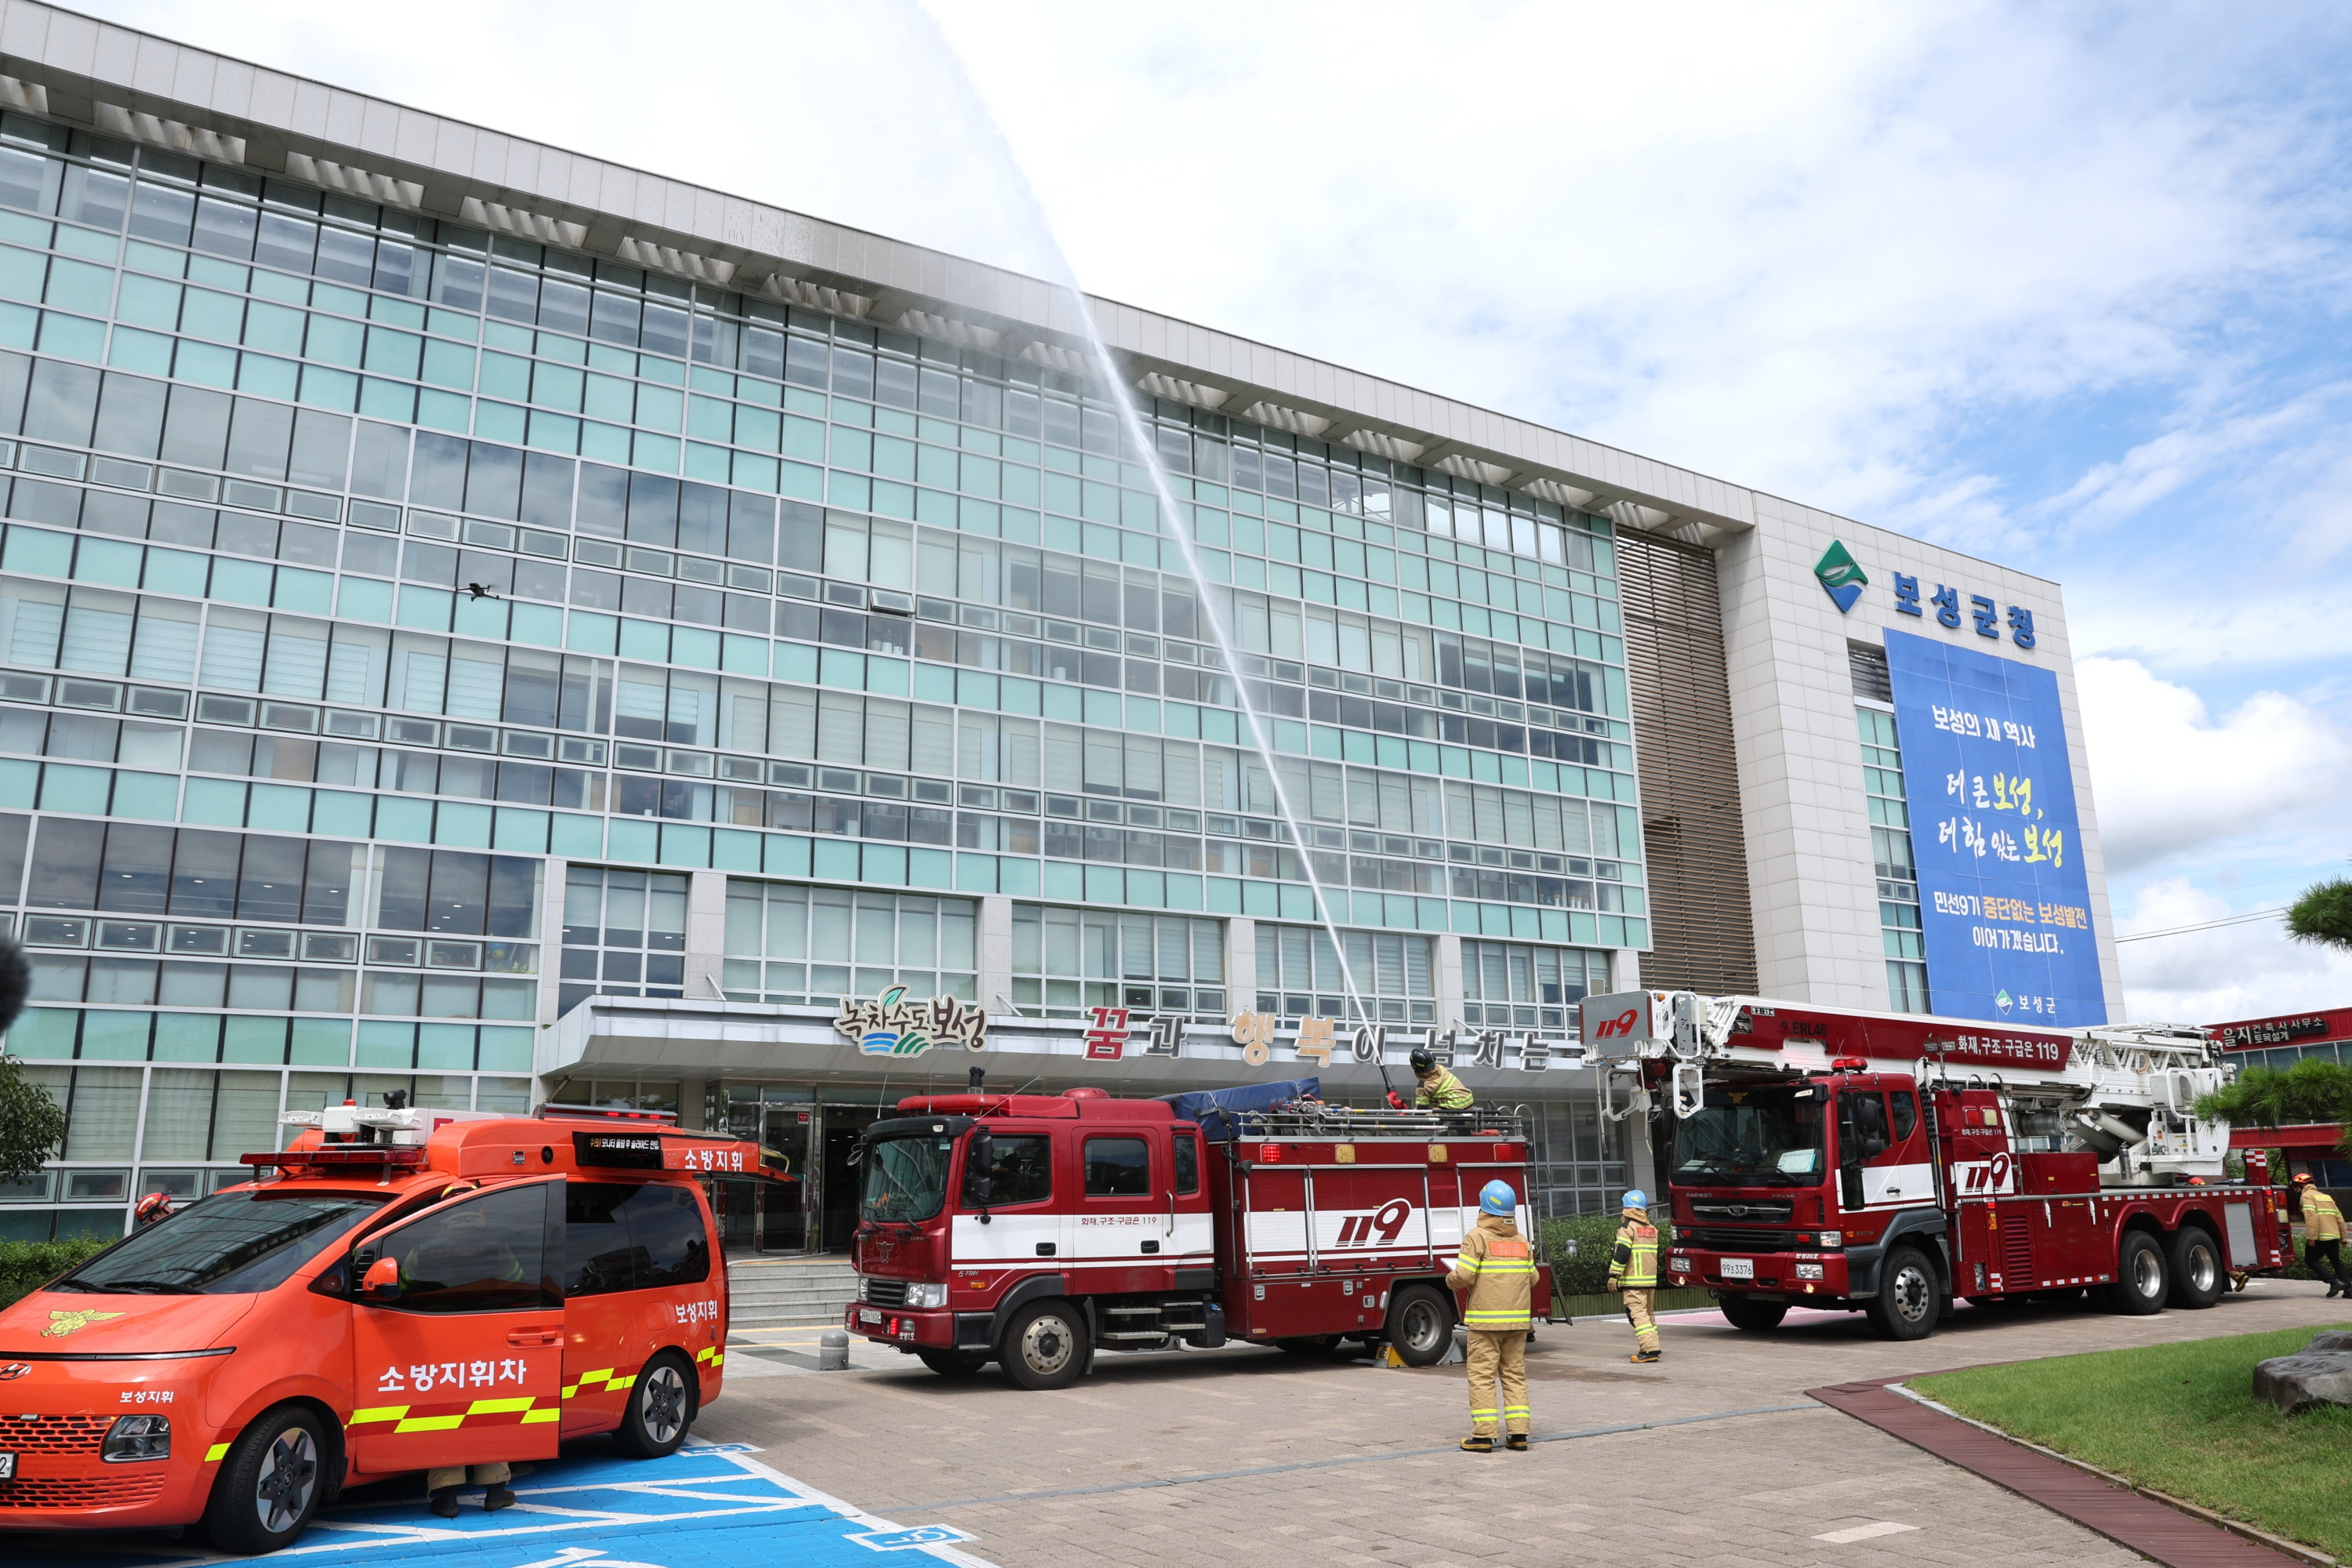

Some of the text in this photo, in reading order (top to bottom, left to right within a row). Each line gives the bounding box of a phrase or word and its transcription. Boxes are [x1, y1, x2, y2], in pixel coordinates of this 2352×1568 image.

[1893, 571, 2036, 648] 보성군청
[1932, 705, 2035, 749] 보성의 새 역사
[1947, 769, 2043, 820] 더 큰 보성,
[1938, 816, 2063, 868] 더 힘 있는 보성
[1933, 891, 2088, 930] 민선9기 중단없는 보성발전
[1973, 926, 2064, 955] 이어가겠습니다.
[2019, 995, 2056, 1014] 보성군
[931, 996, 985, 1048] 보성
[1595, 1009, 1639, 1040] 119
[1792, 1022, 1828, 1036] ERL46
[2222, 1025, 2252, 1047] 을지
[1082, 1006, 1188, 1061] 꿈과
[1424, 1029, 1552, 1072] 넘치는
[2036, 1042, 2060, 1061] 119
[2254, 1031, 2289, 1044] 토목설계
[590, 1138, 601, 1147] 주의!
[601, 1138, 615, 1148] 모니터
[616, 1139, 625, 1149] 올림
[626, 1140, 630, 1149] 후
[631, 1140, 649, 1149] 슬라이드
[684, 1149, 742, 1171] 소방지휘
[1965, 1151, 2011, 1192] 119
[1335, 1200, 1410, 1247] 119
[1722, 1263, 1752, 1276] 99조3376
[675, 1300, 717, 1323] 보성지휘
[378, 1359, 527, 1392] 소방지휘차
[119, 1391, 174, 1403] 보성지휘
